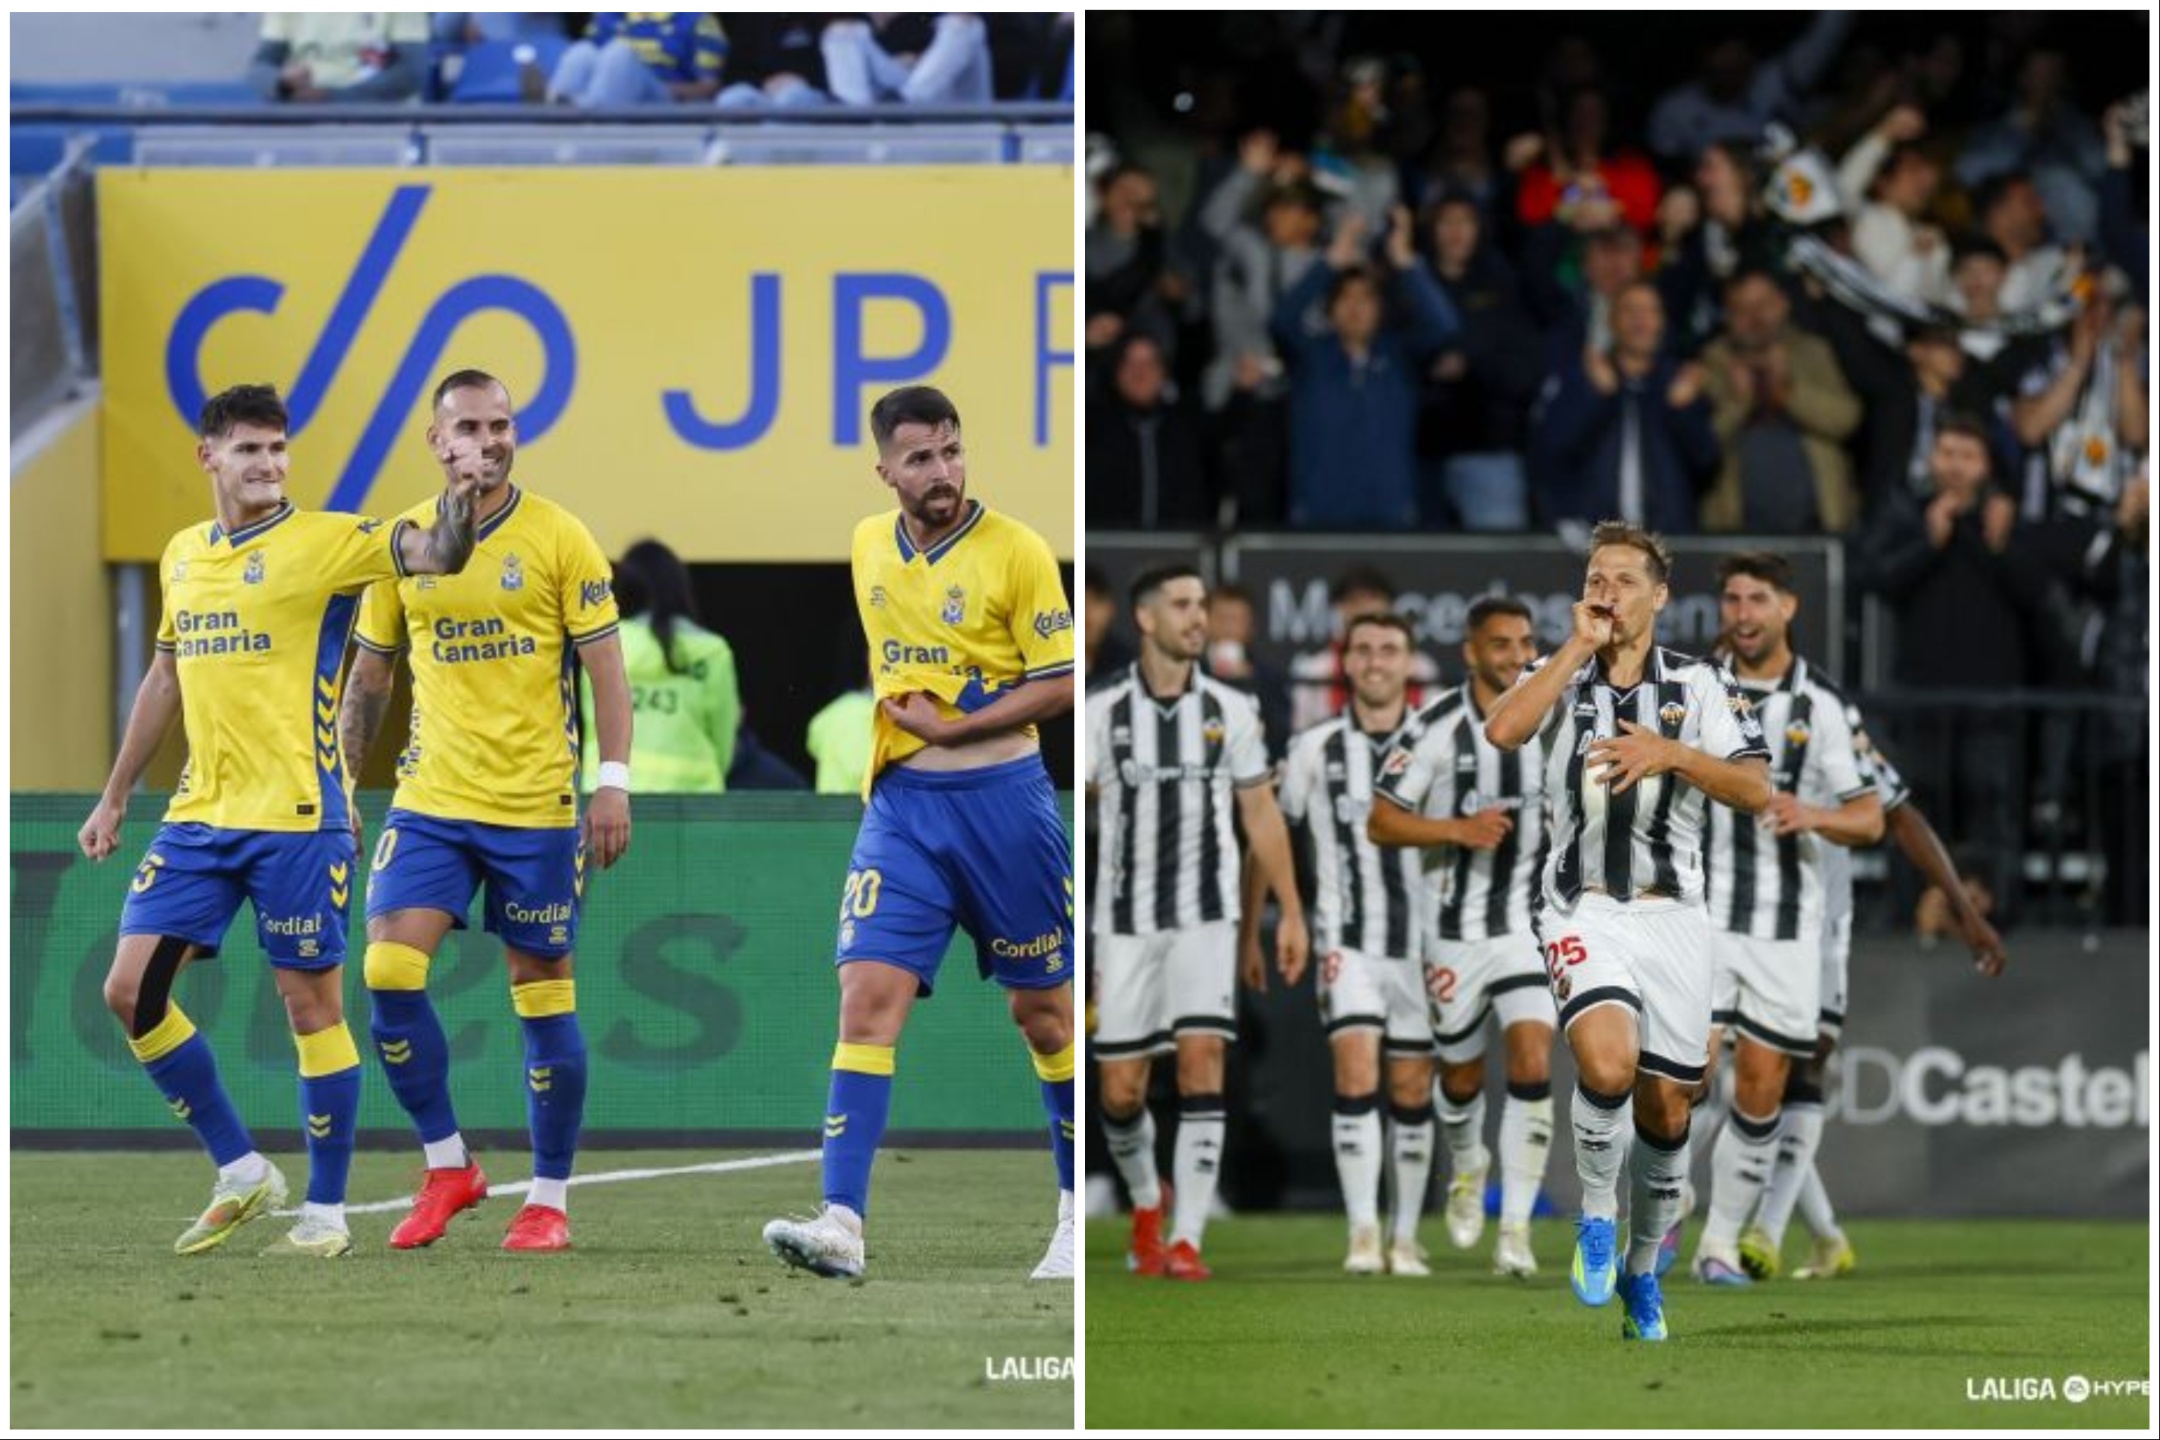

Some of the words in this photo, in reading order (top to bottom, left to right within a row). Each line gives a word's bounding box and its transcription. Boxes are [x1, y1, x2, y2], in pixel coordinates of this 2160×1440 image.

[661, 272, 952, 452] JP
[177, 610, 237, 632] Gran
[434, 617, 504, 639] Gran
[883, 639, 948, 664] Gran
[505, 899, 572, 924] Cordial
[991, 926, 1063, 958] Cordial
[1547, 937, 1588, 979] 25
